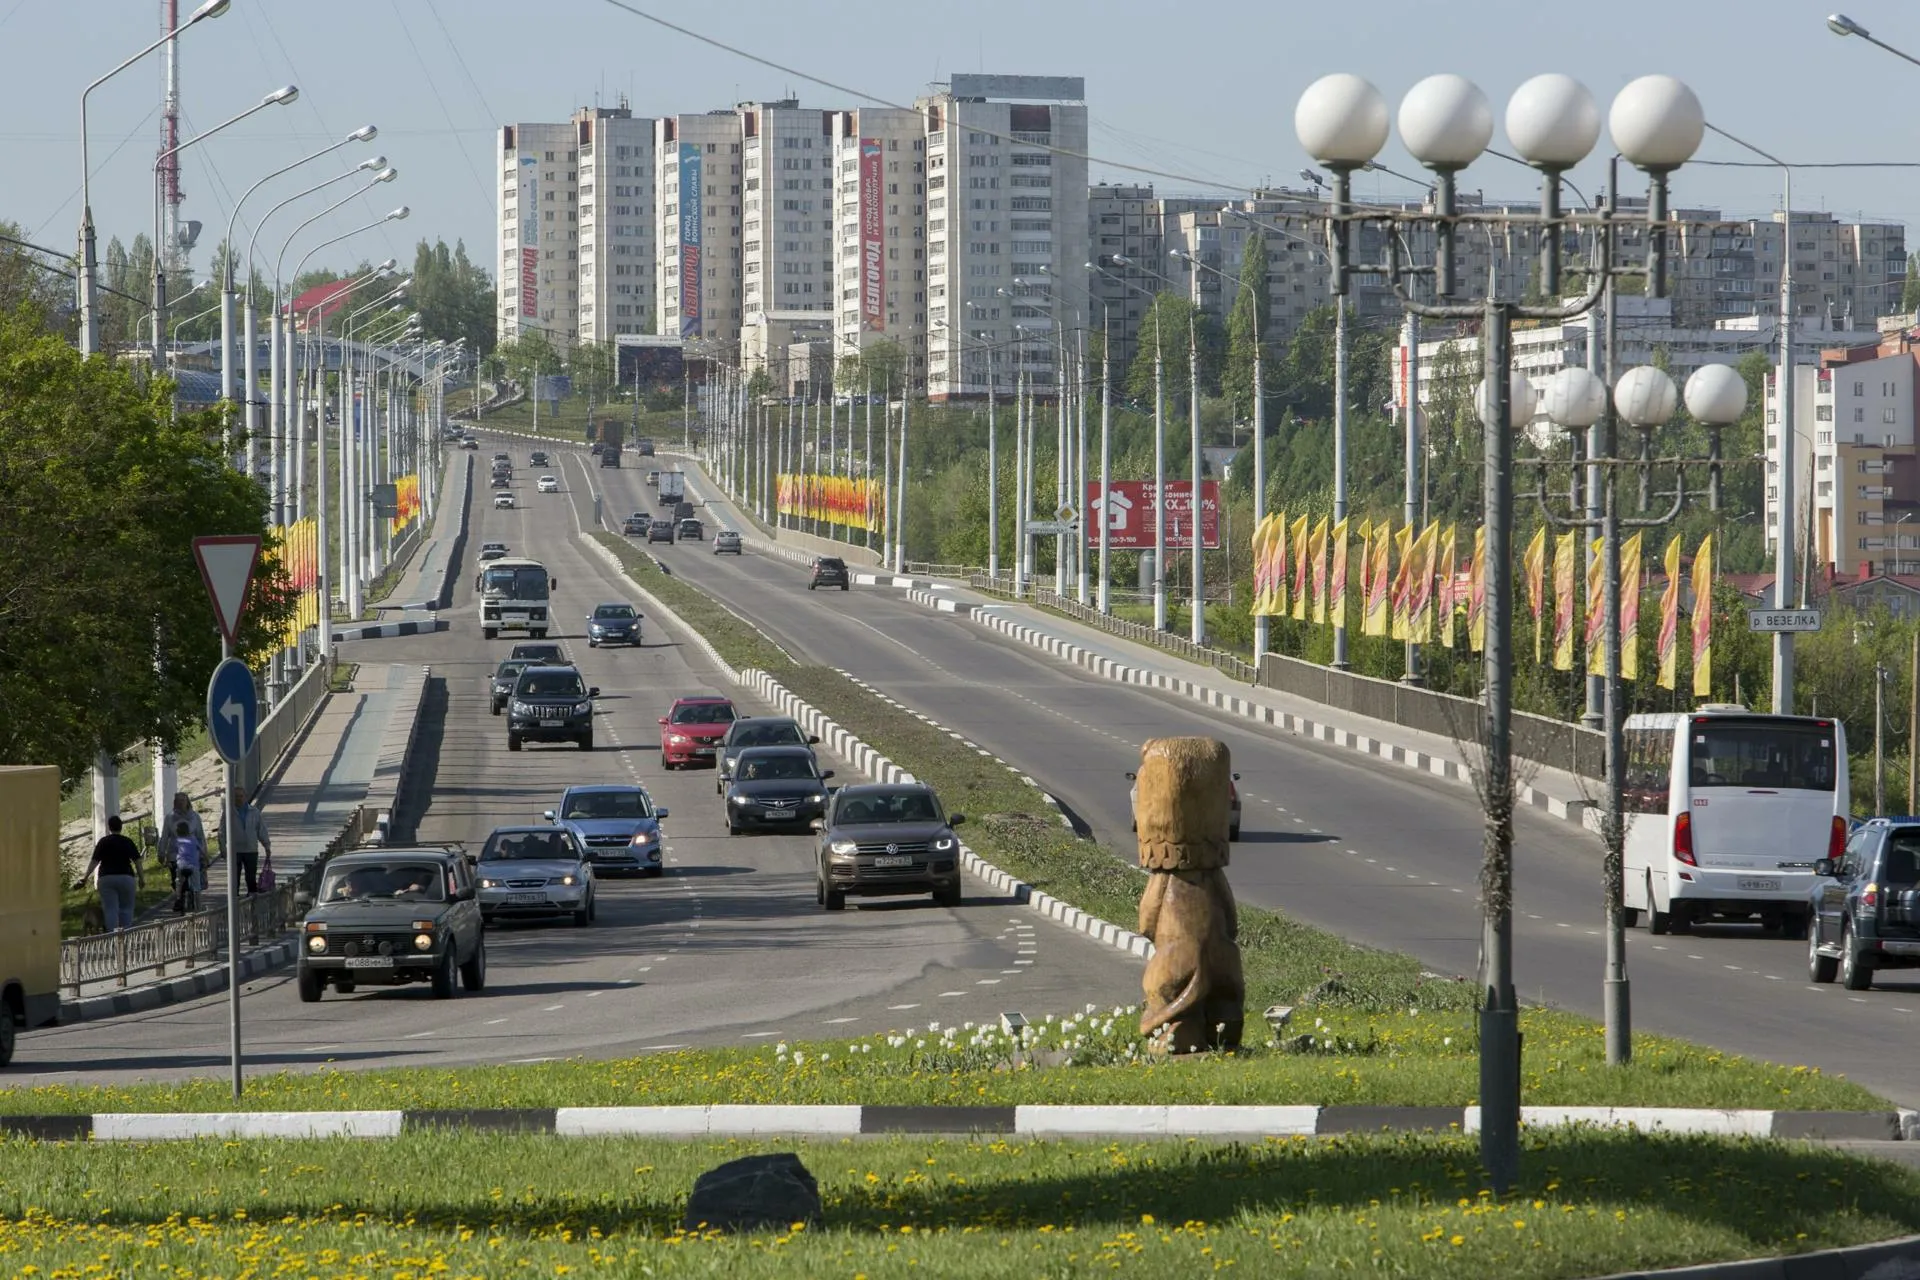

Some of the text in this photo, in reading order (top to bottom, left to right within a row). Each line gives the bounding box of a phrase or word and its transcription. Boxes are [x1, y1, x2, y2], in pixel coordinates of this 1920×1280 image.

[523, 248, 539, 317] БЕЛГОРОД
[684, 245, 699, 318] БЕЛГОРОД
[866, 239, 881, 316] БЕЛГОРОД
[1766, 615, 1816, 626] ВЕЗЕЛКА
